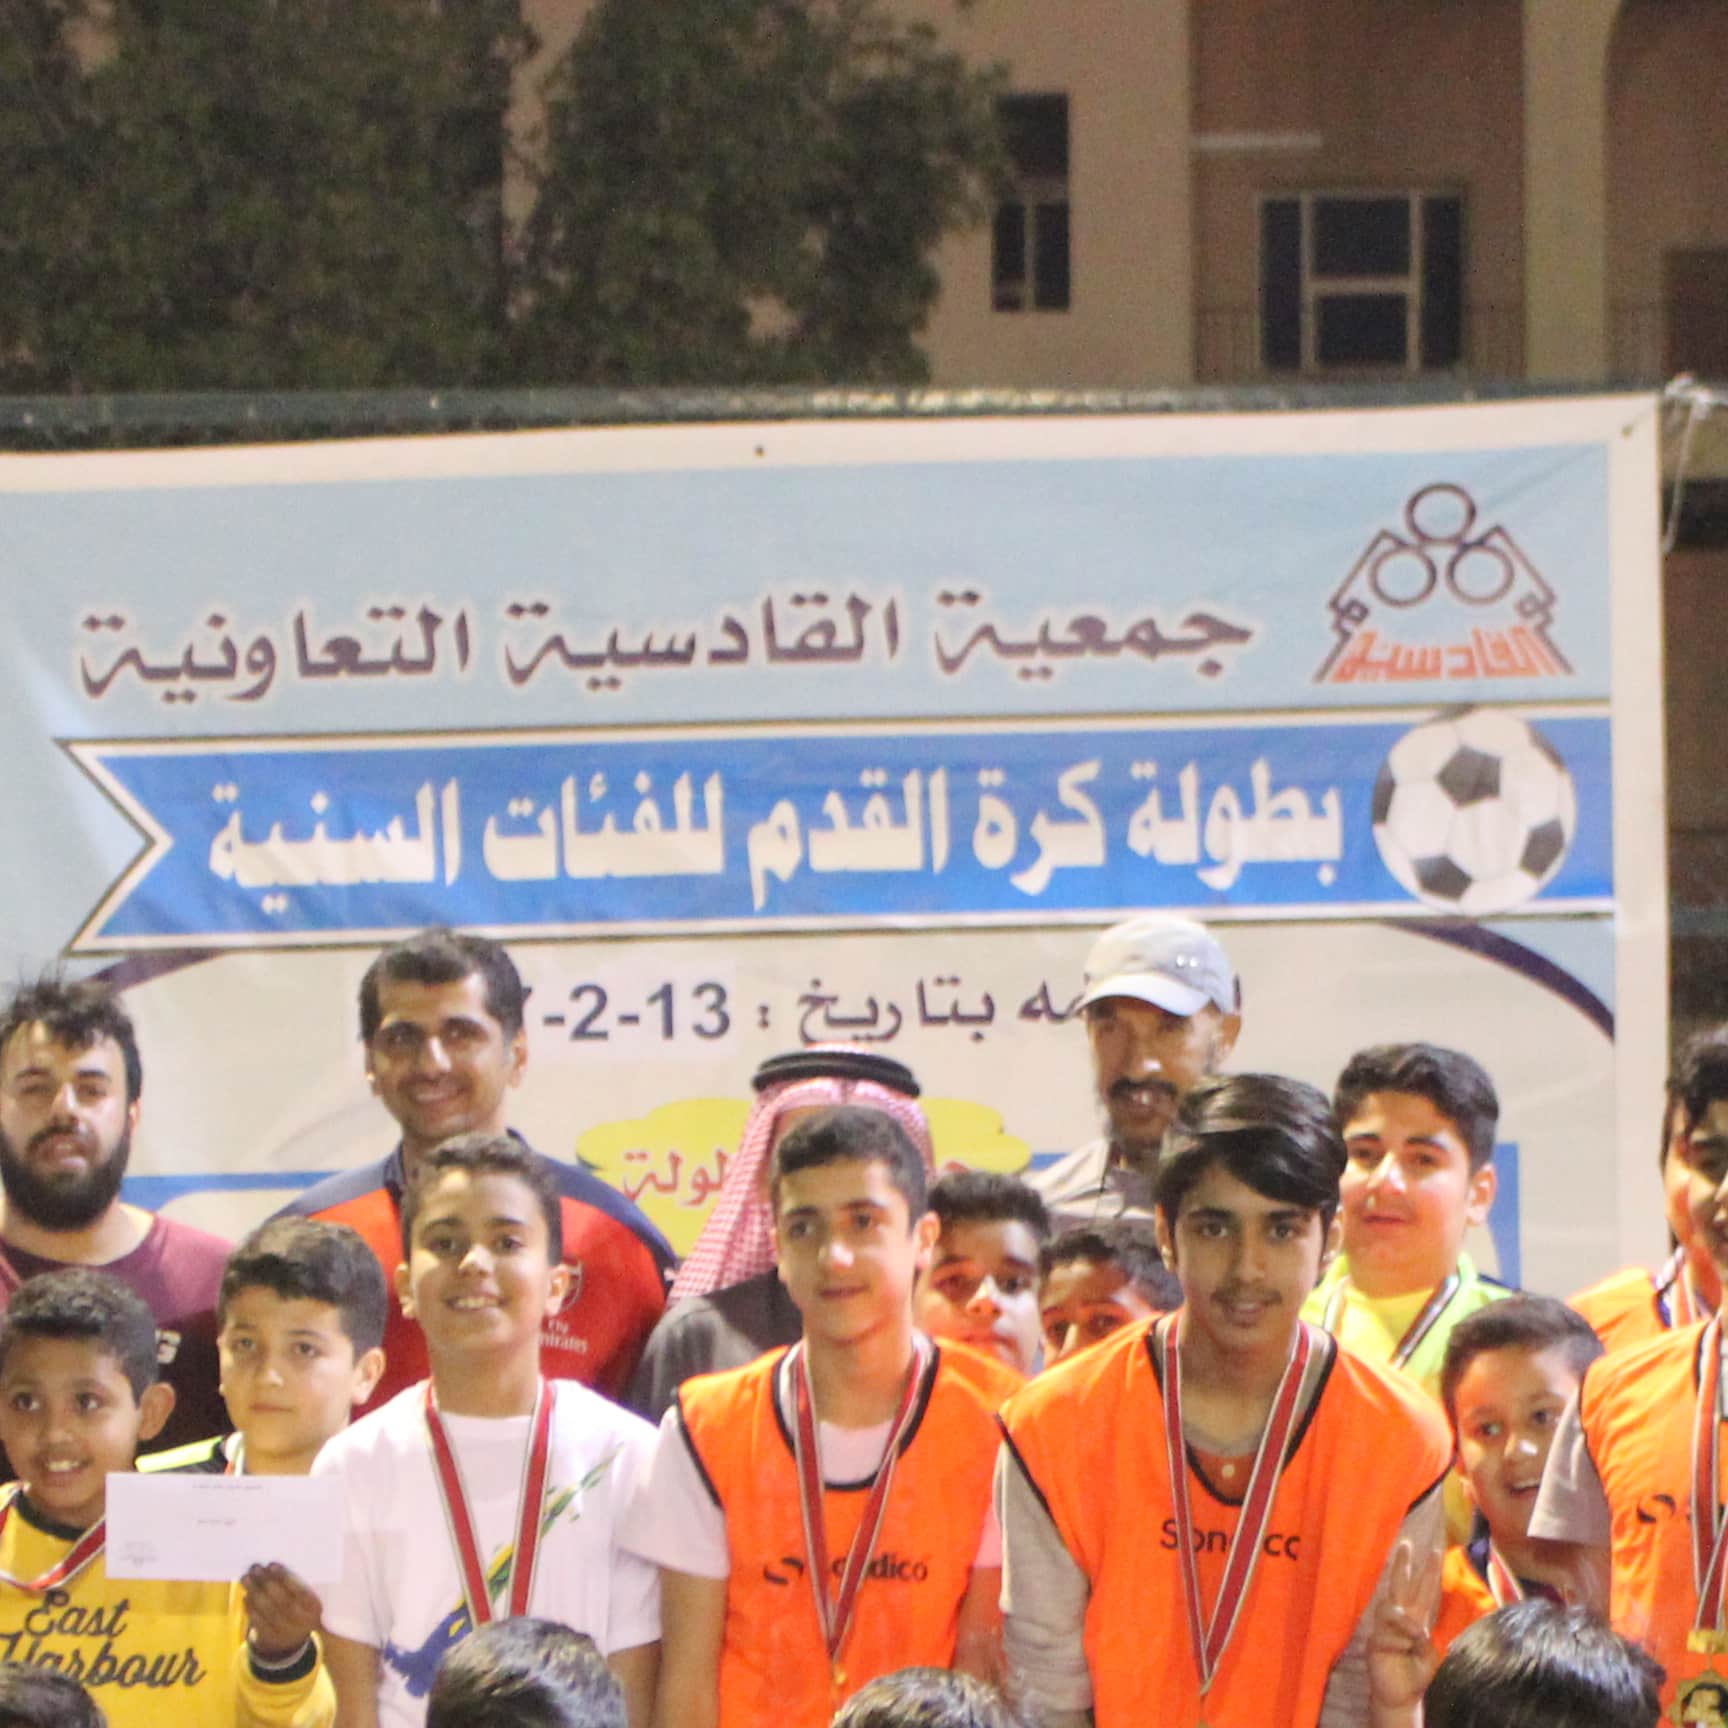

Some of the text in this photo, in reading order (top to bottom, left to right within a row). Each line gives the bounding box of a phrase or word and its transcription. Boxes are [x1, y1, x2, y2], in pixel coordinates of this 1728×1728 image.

[80, 590, 1252, 704] جمعية القادسية التعاونية
[208, 757, 1343, 914] بطولة كرة القدم للفئات السنية
[522, 981, 731, 1041] -2-13
[797, 974, 996, 1045] بتاريخ
[540, 1334, 588, 1353] mirates
[24, 1588, 130, 1638] East
